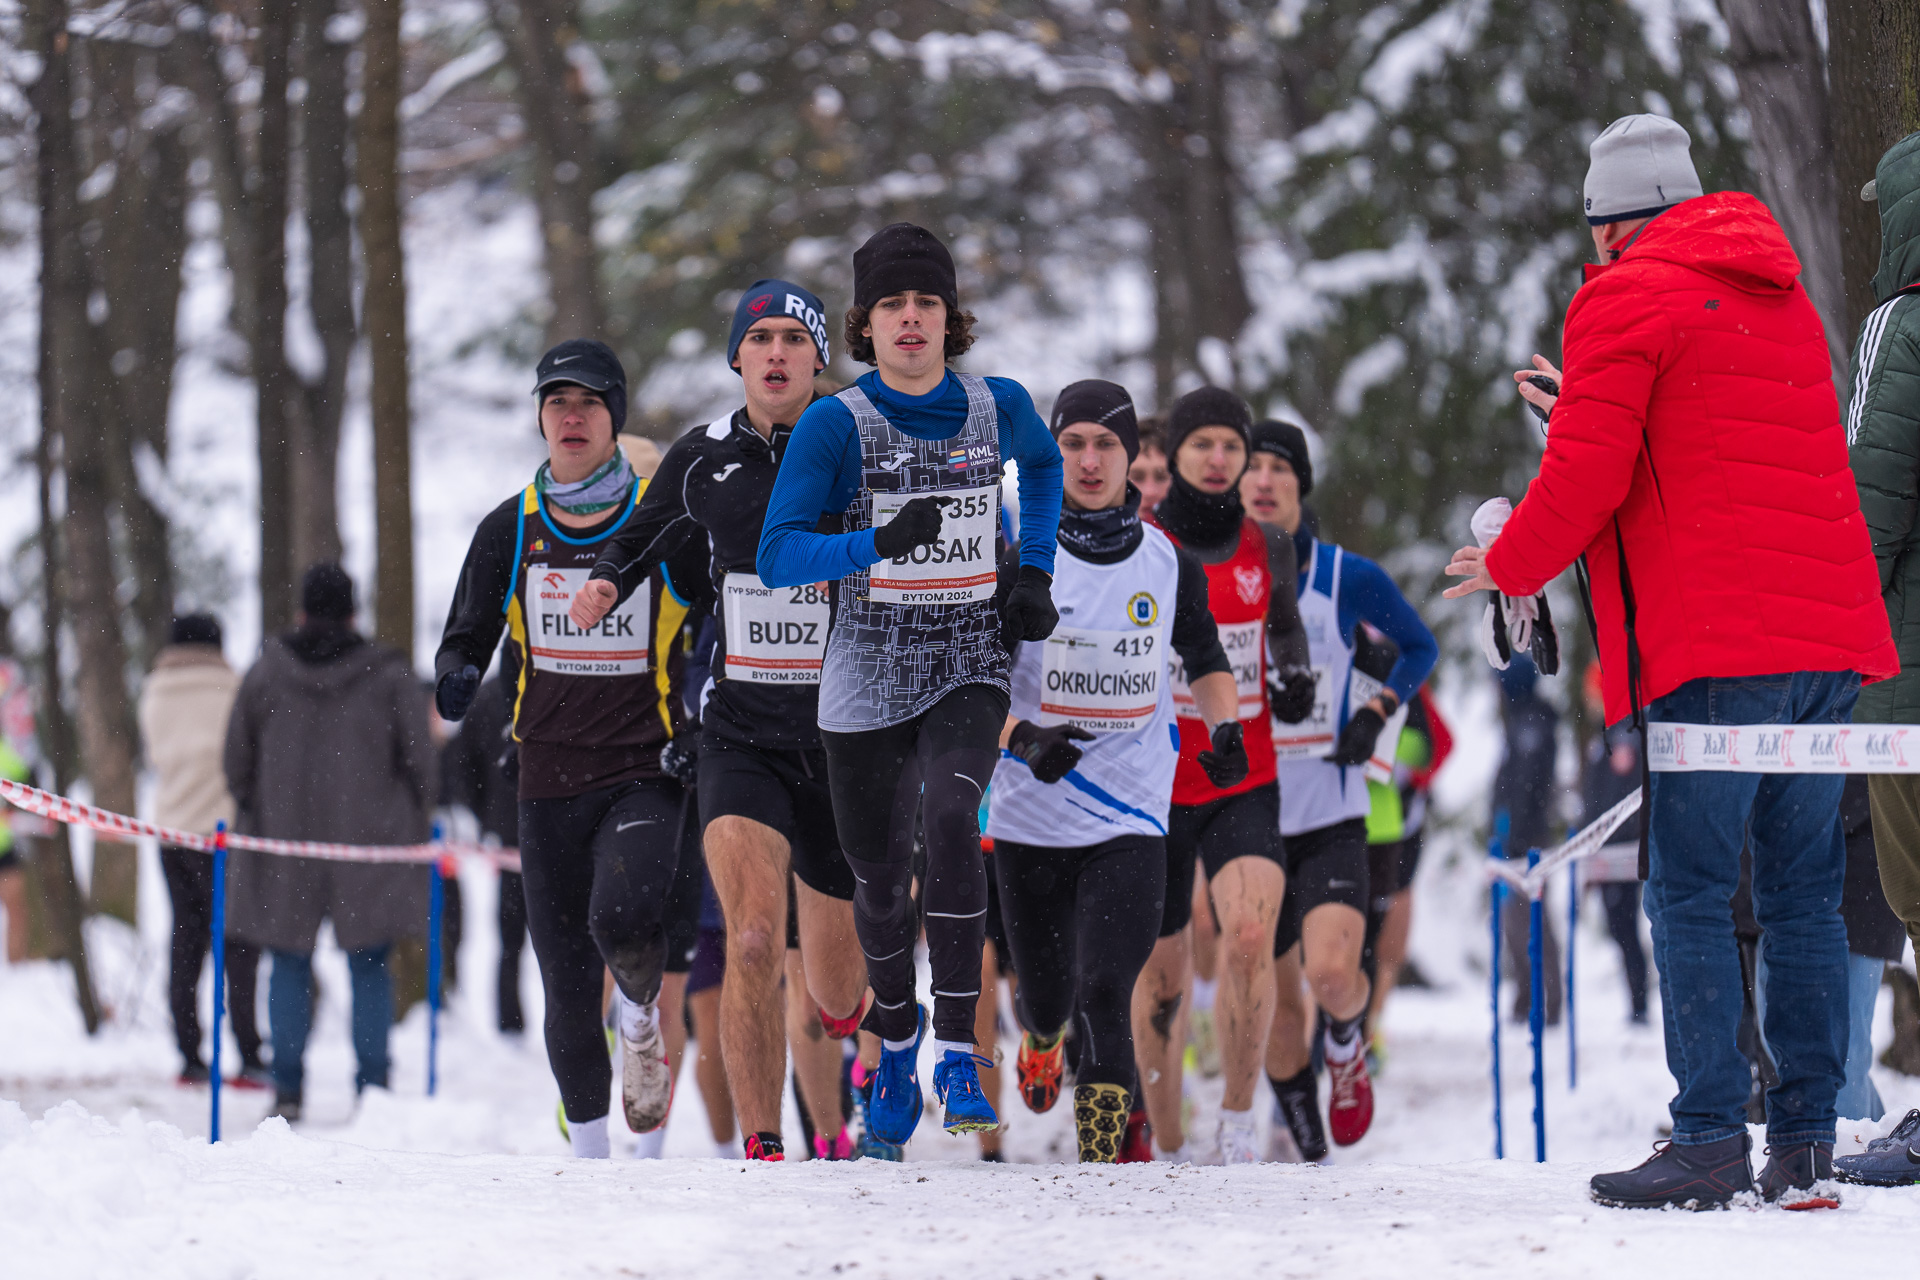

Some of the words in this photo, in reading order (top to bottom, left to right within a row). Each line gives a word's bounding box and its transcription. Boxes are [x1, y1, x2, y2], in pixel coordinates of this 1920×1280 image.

[967, 444, 995, 460] KML
[970, 457, 995, 467] LUBACZÓW
[948, 493, 988, 519] 355
[948, 579, 969, 587] Biegach
[540, 591, 569, 600] ORLEN
[727, 586, 744, 595] TVP
[745, 588, 774, 597] SPORT
[902, 592, 944, 602] BYTOM
[946, 590, 973, 601] 2024
[749, 620, 819, 645] BUDZ
[1226, 628, 1256, 650] 207
[1113, 635, 1155, 657] 419
[556, 661, 593, 672] BYTOM
[595, 662, 621, 672] 2024
[752, 670, 789, 681] BYTOM
[791, 672, 819, 681] 2024
[1047, 669, 1156, 696] OKRUCIŃSKI
[1068, 719, 1107, 729] BYTOM
[1110, 721, 1135, 729] 2024
